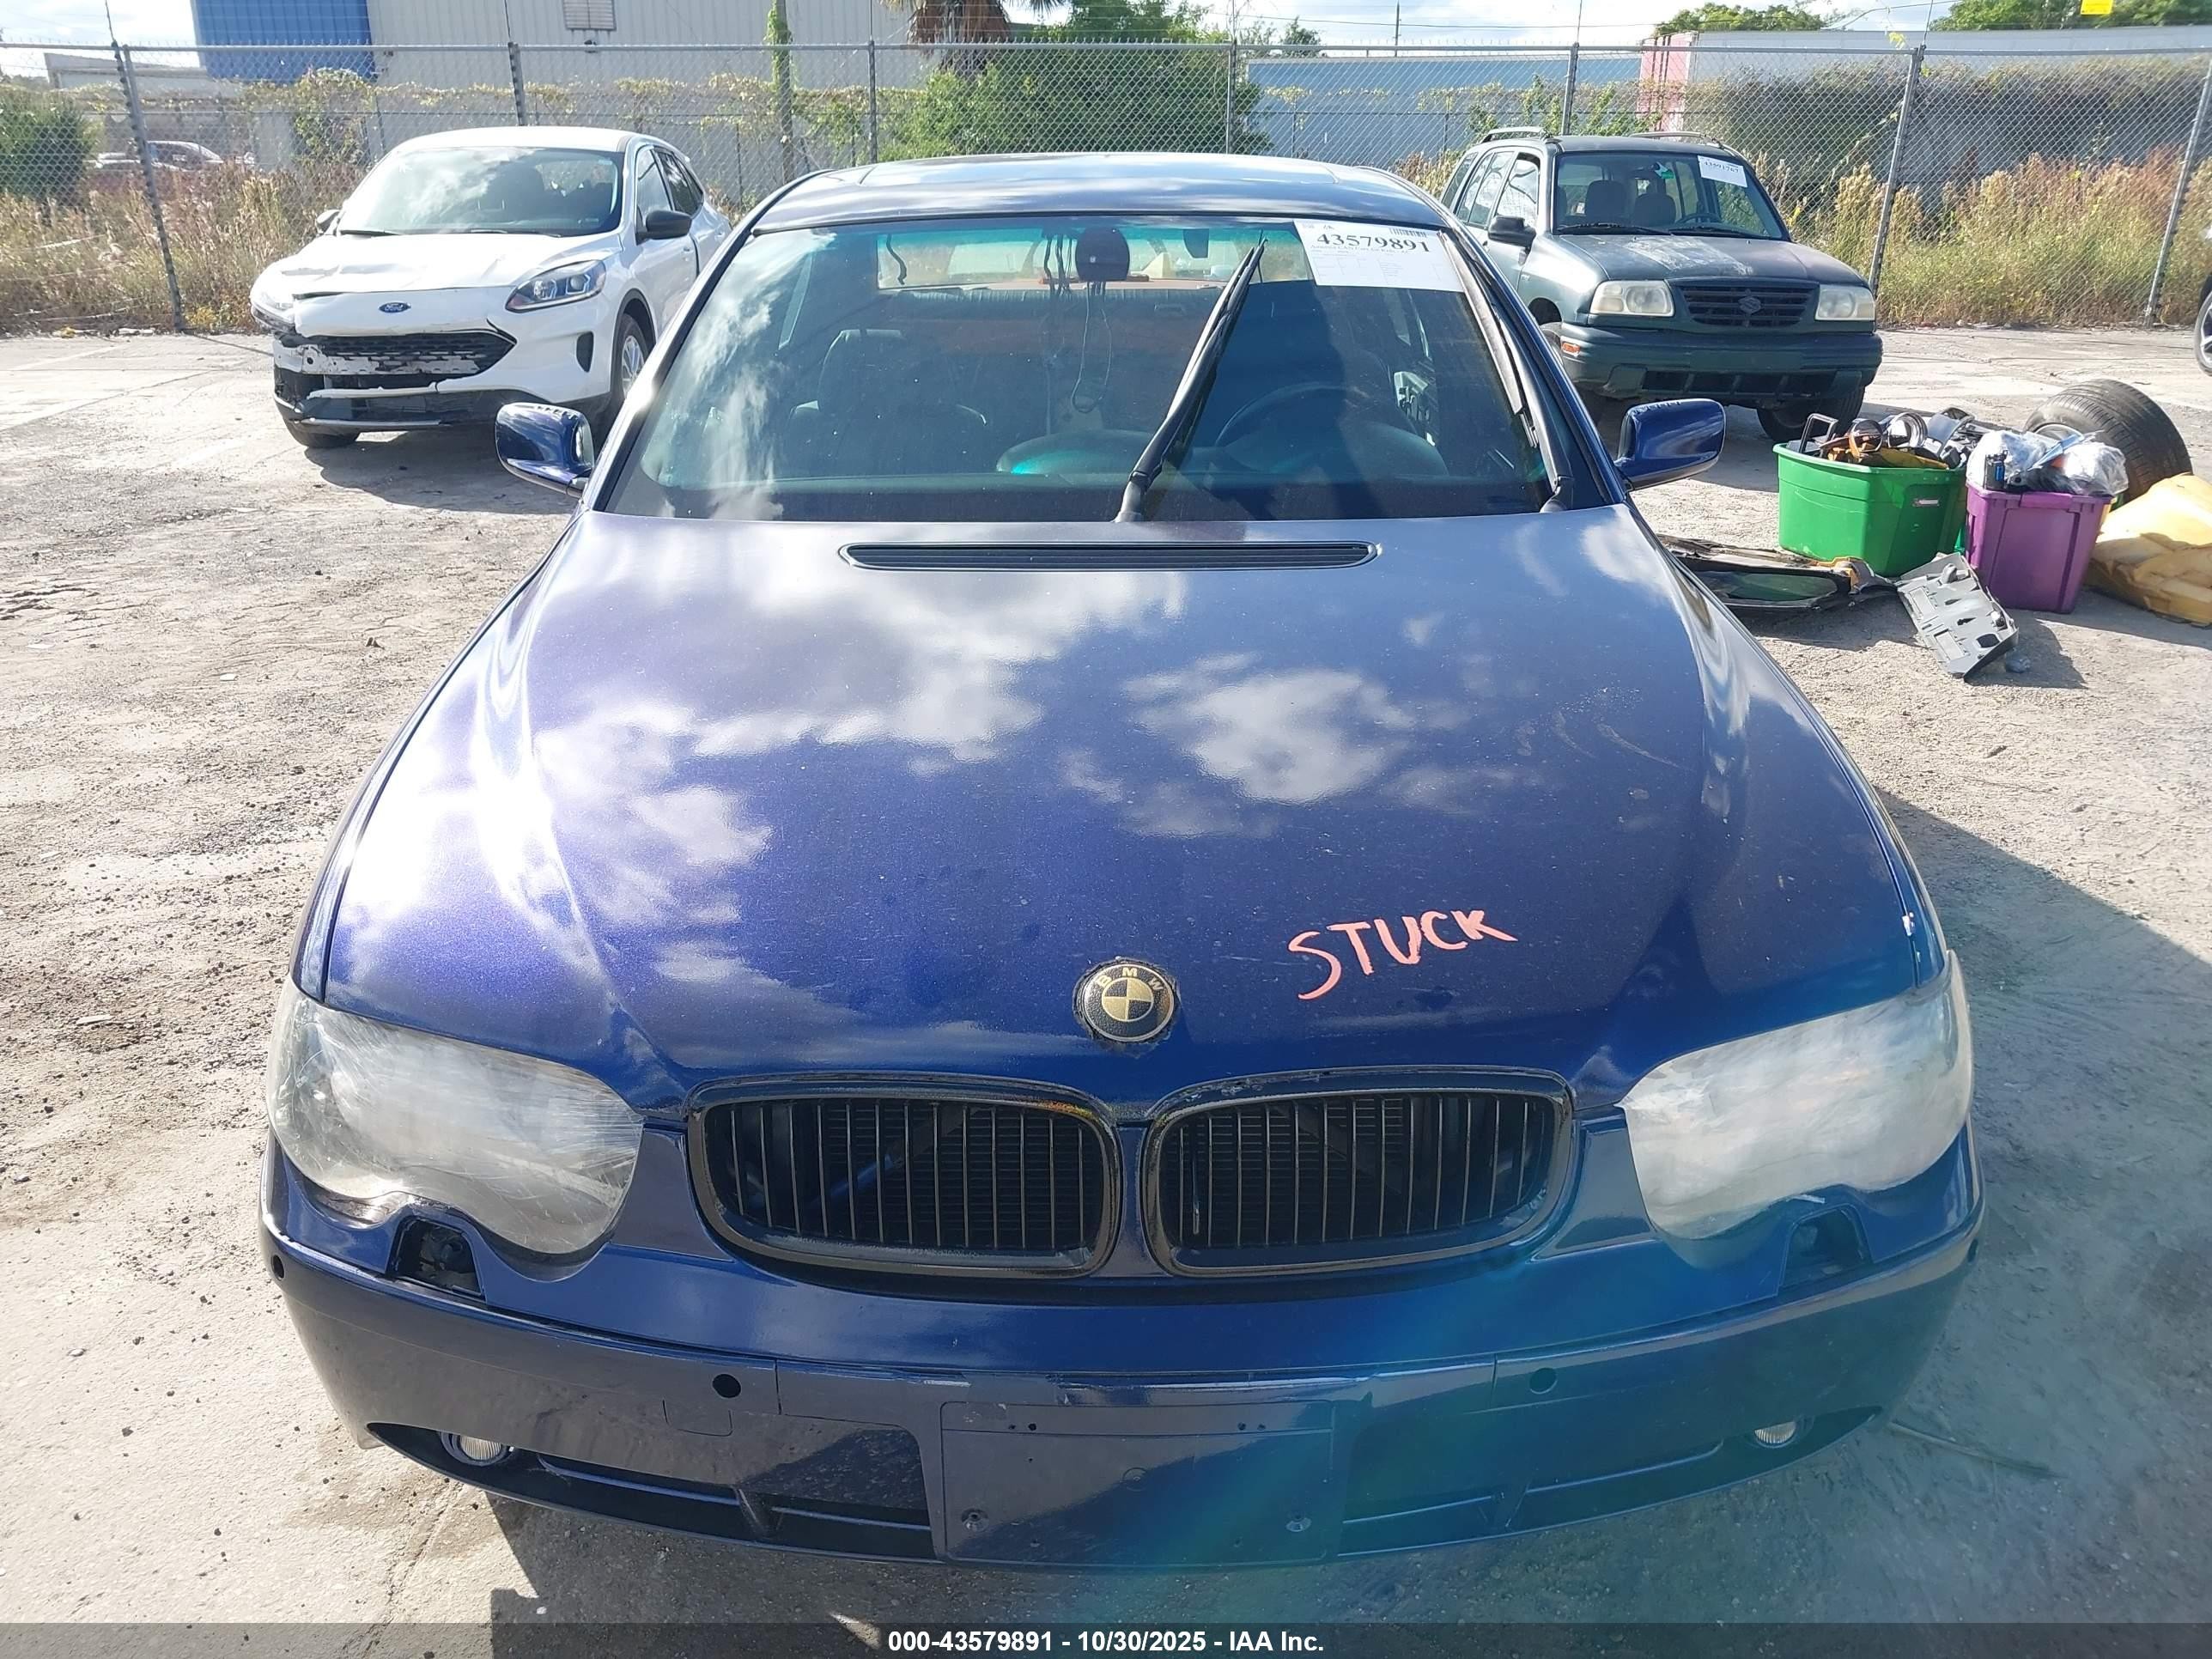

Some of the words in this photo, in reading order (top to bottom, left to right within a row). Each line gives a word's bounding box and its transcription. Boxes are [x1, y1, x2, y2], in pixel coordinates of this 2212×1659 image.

[1316, 233, 1431, 252] 43579891
[1287, 910, 1518, 1000] STUCK
[1096, 967, 1164, 993] BMW
